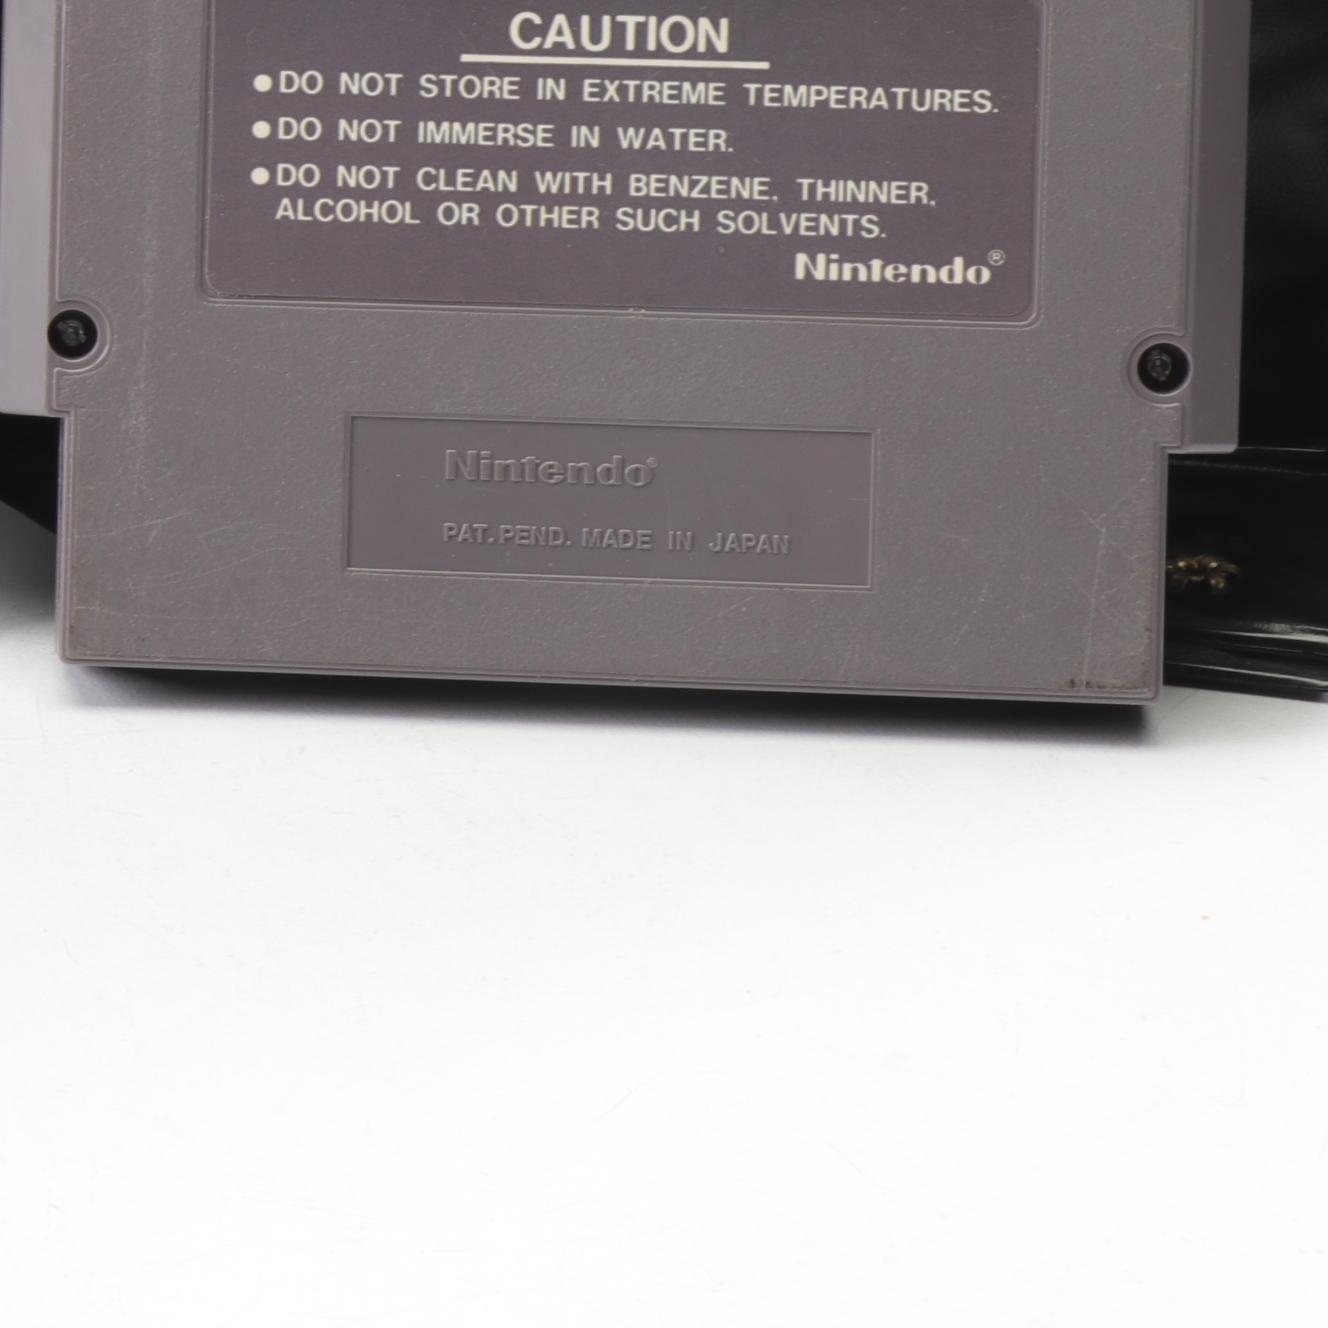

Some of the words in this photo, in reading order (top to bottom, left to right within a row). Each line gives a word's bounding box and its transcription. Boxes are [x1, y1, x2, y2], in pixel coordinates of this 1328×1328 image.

[509, 11, 729, 54] CAUTION
[279, 70, 324, 95] DO
[339, 71, 403, 97] NOT
[419, 73, 521, 100] STORE
[537, 77, 566, 101] IN
[582, 78, 726, 106] EXTREME
[742, 83, 999, 114] TEMPERATURES.
[277, 116, 322, 141] DO
[338, 118, 402, 143] NOT
[418, 120, 555, 148] IMMERSE
[571, 125, 600, 148] IN
[617, 126, 734, 152] WATER.
[276, 163, 321, 188] DO
[337, 164, 401, 190] NOT
[416, 166, 518, 193] CLEAN
[534, 171, 612, 195] WITH
[275, 197, 421, 224] ALCOHOL
[437, 201, 480, 226] OR
[496, 203, 600, 229] OTHER
[615, 206, 700, 233] SUCH
[717, 209, 886, 239] SOLVENTS.
[581, 527, 653, 552] MADE
[668, 530, 693, 552] IN
[708, 532, 790, 556] JAPAN
